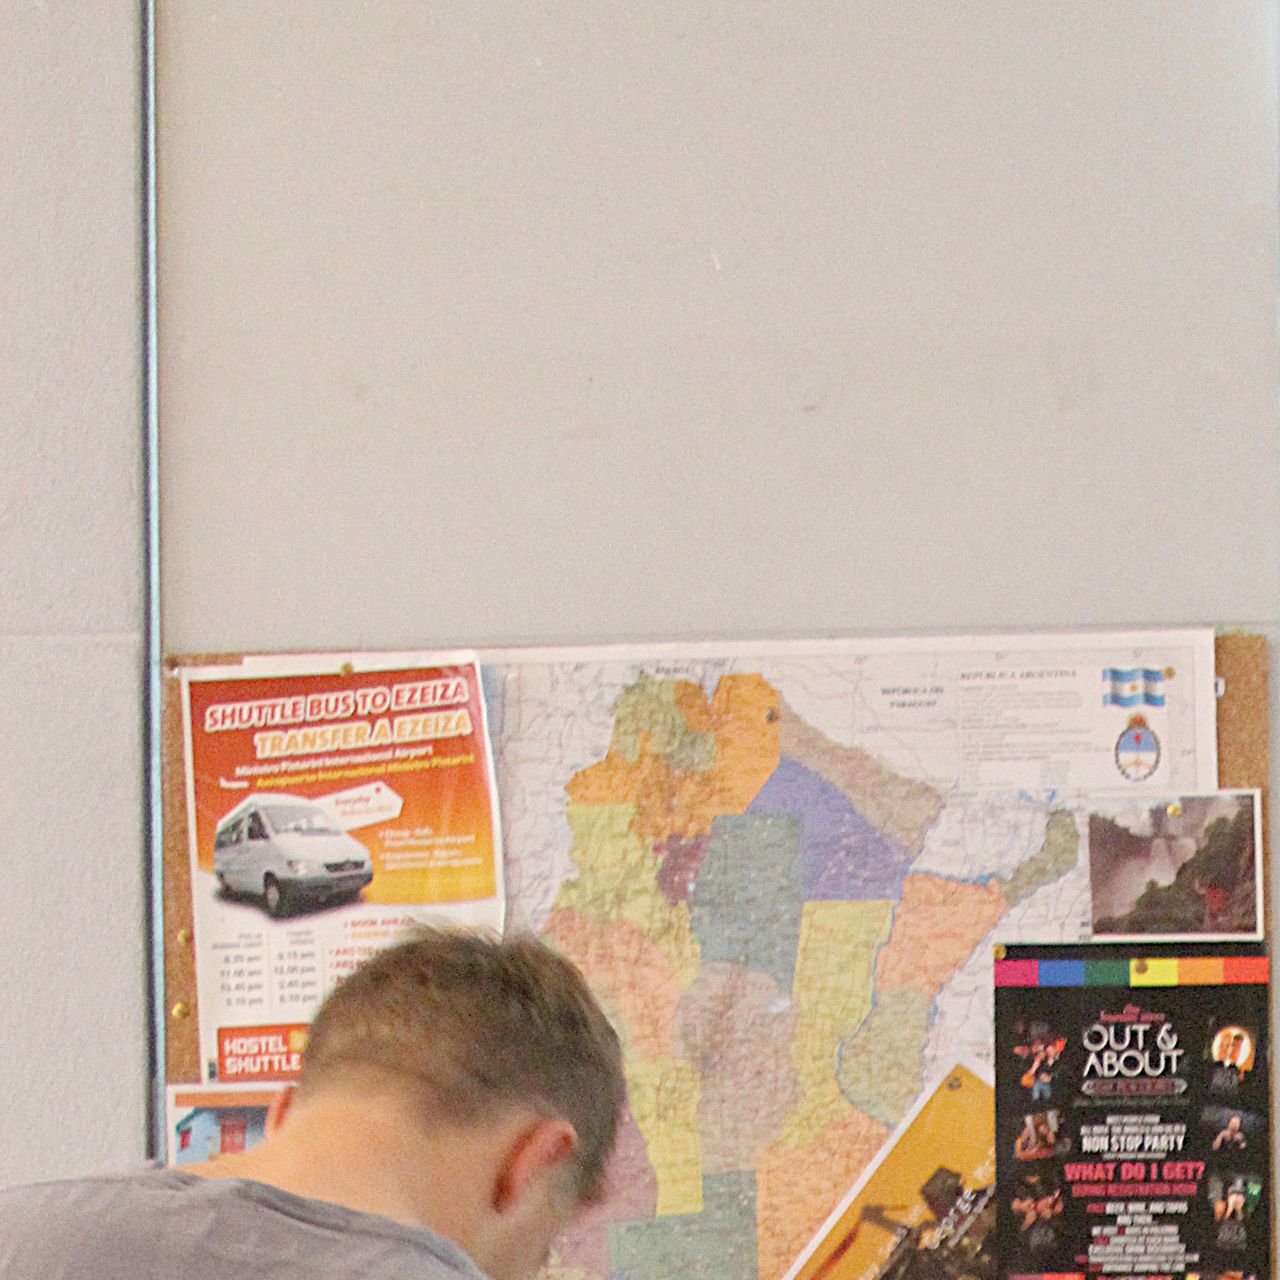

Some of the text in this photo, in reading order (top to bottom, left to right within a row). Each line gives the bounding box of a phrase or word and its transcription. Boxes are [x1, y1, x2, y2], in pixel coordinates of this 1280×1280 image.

[205, 677, 468, 732] SHUTTLE BUS TO EZEIZA
[254, 710, 472, 759] TRANSFER A EZEIZA
[224, 1034, 287, 1055] HOSTEL
[1083, 1023, 1178, 1051] OUT &
[225, 1053, 301, 1075] SHUTTLE
[1083, 1049, 1185, 1077] ABOUT
[1082, 1134, 1185, 1152] NON STOP PARTY
[1064, 1161, 1205, 1181] WHAT DO I GET?
